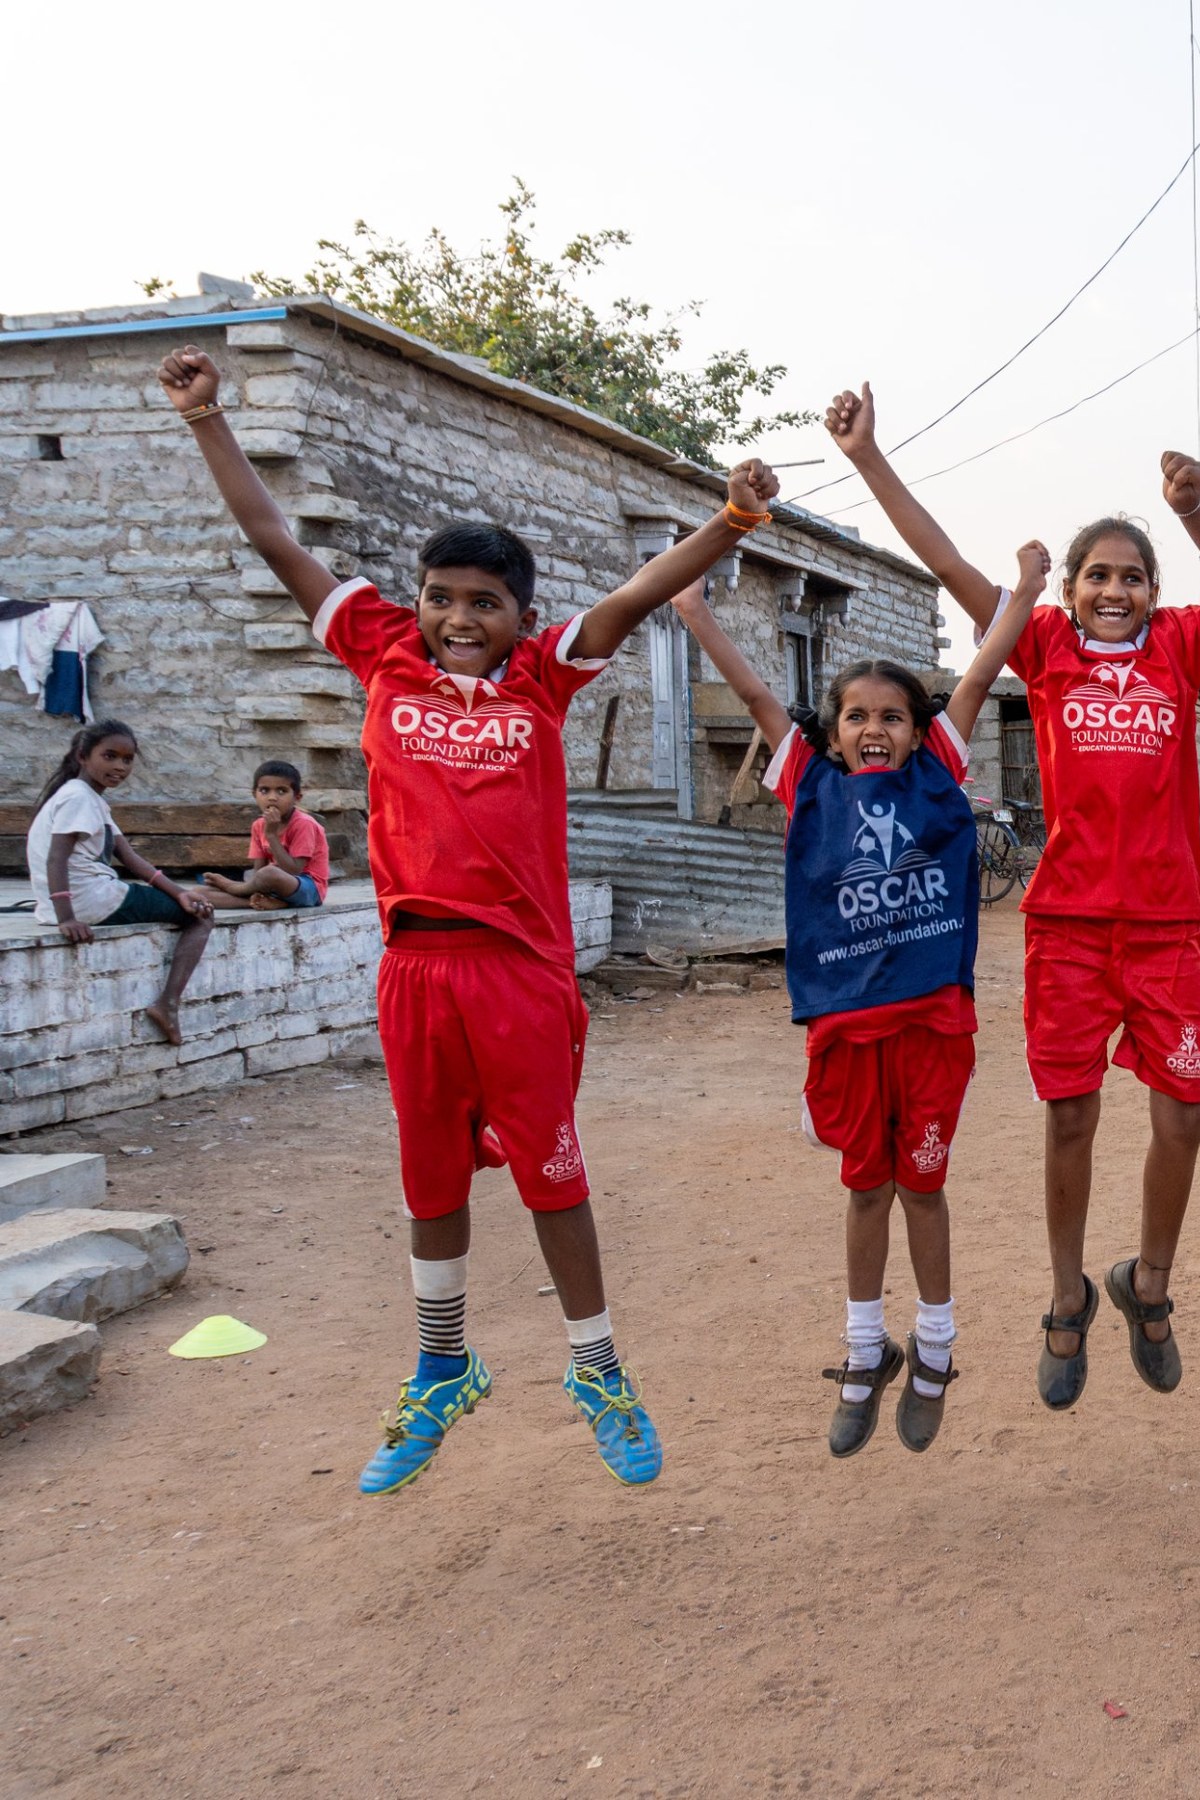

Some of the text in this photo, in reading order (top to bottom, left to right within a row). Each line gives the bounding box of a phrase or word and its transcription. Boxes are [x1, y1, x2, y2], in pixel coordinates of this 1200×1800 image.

[391, 704, 533, 749] OSCAR
[1062, 701, 1176, 736] OSCAR
[401, 736, 518, 764] FOUNDATION
[1071, 730, 1163, 749] FOUNDATION
[1078, 745, 1116, 753] EDUCATION
[412, 753, 455, 767] EDUCATION
[455, 761, 478, 770] WITH
[485, 764, 506, 772] KICK
[837, 867, 949, 919] OSCAR
[850, 900, 944, 933] FOUNDATION
[817, 917, 965, 965] www.oscar-foundation.
